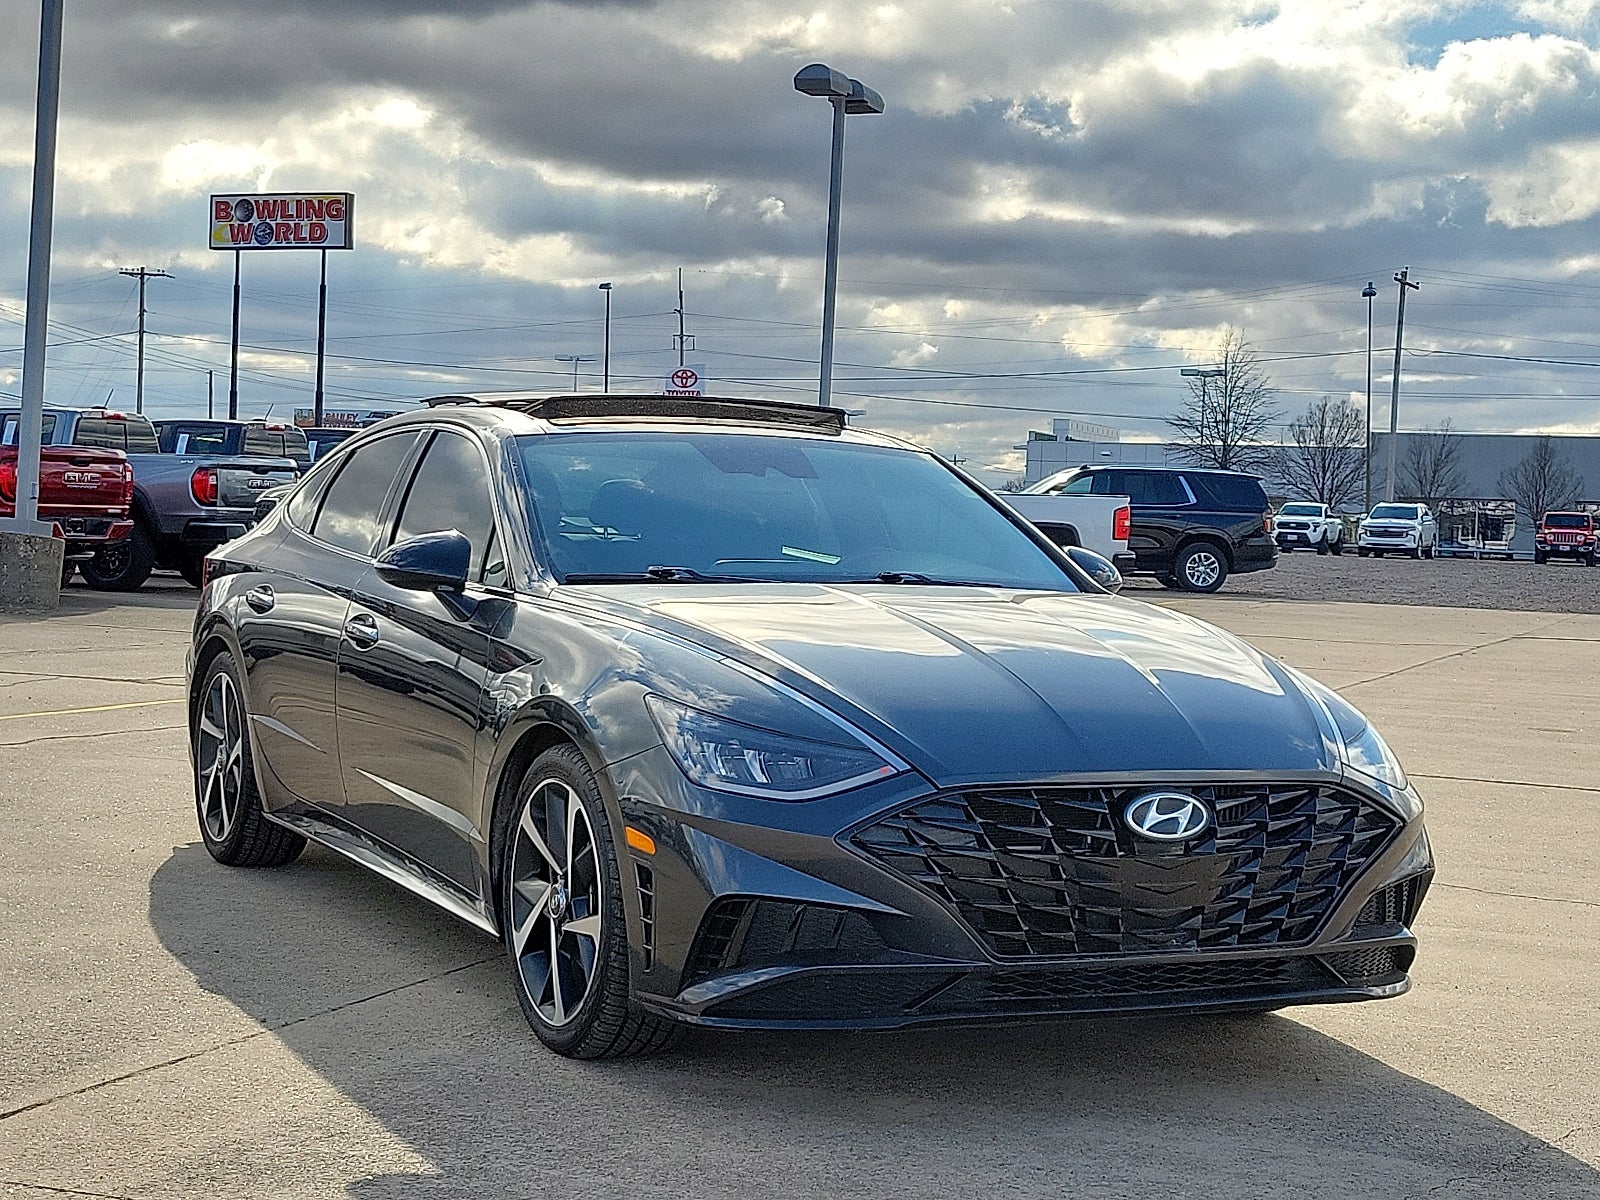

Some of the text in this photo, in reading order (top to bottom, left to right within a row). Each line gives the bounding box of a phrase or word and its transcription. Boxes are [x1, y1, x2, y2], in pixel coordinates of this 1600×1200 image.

[214, 198, 344, 222] BOWLING
[229, 222, 328, 245] WORLD
[665, 389, 702, 397] TOYOTA
[64, 472, 100, 483] GMC
